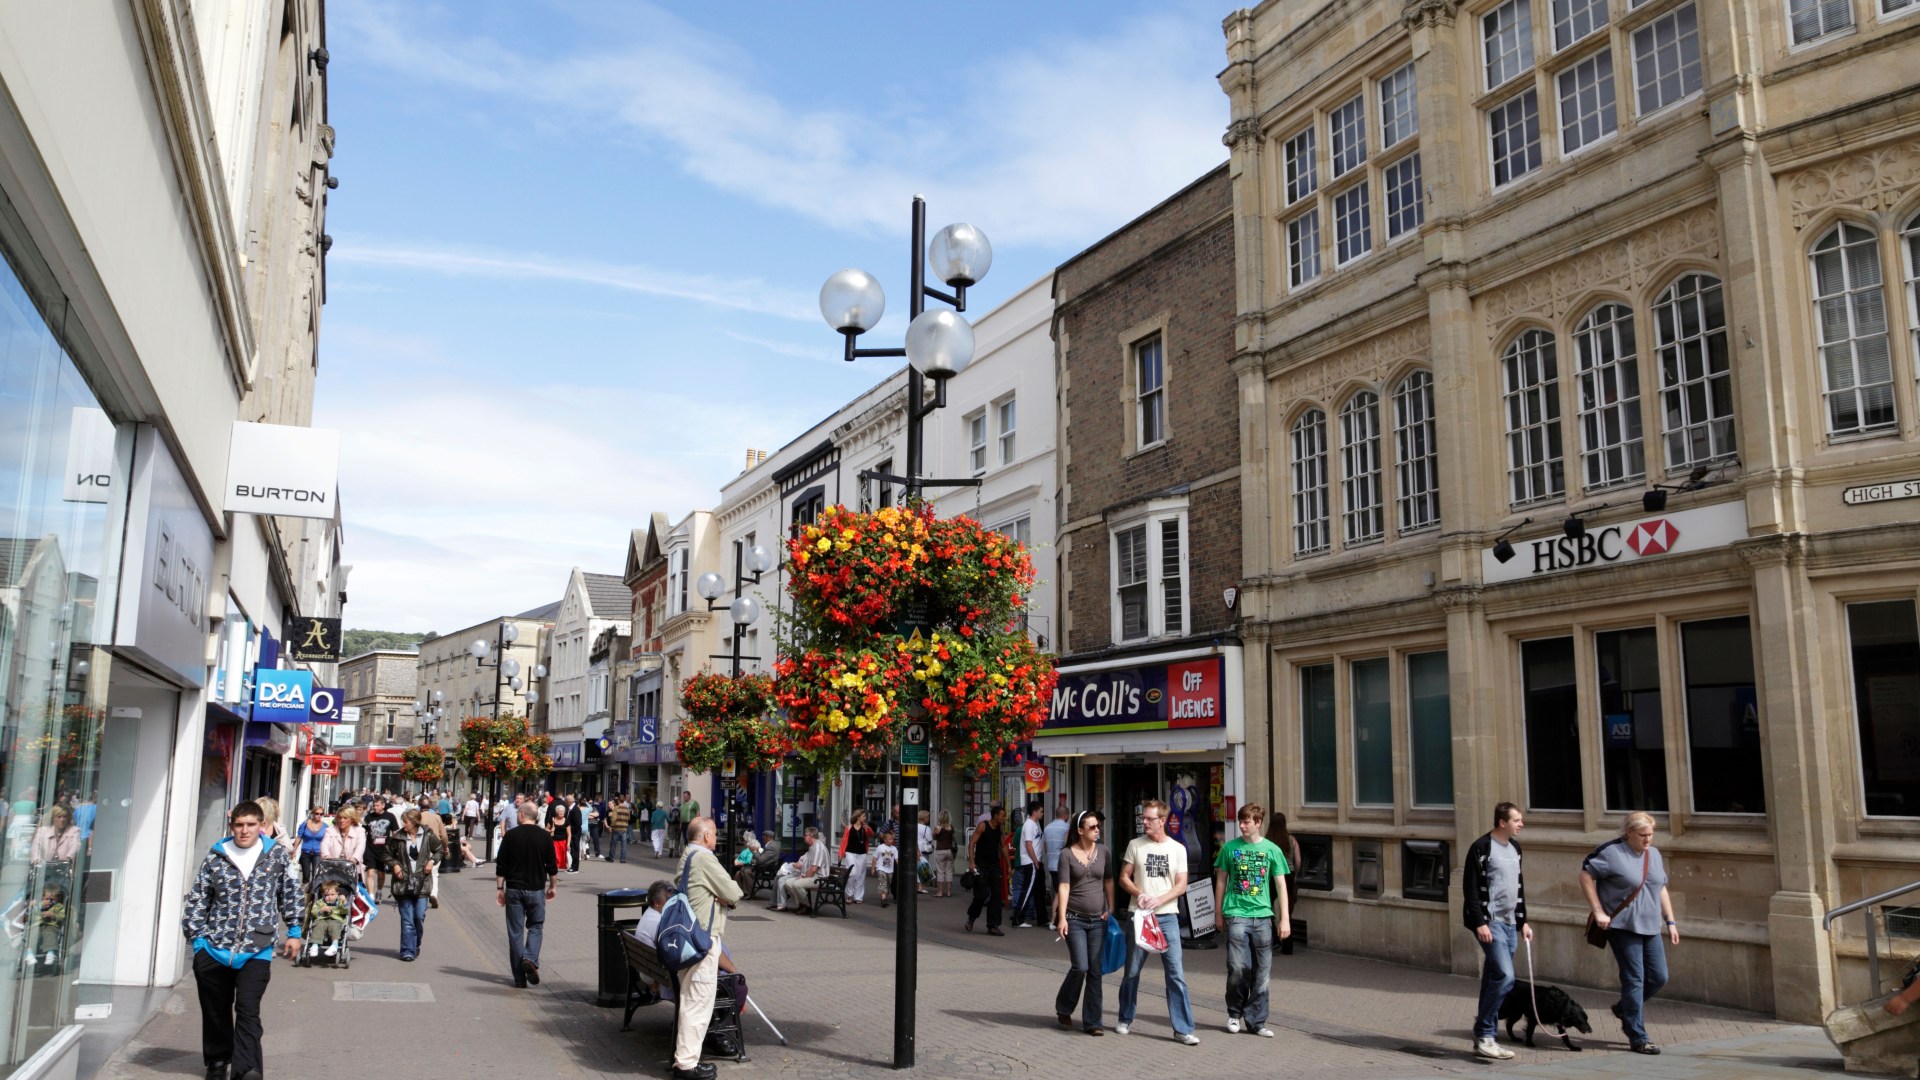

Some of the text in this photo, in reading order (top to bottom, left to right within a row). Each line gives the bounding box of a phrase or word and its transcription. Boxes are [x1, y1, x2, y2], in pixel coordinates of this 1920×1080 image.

[235, 484, 326, 503] BURTON
[1852, 485, 1893, 502] HIGH
[1532, 526, 1622, 573] HSBC
[301, 619, 331, 650] A
[295, 651, 335, 660] Accessorize
[259, 682, 305, 703] D&A
[272, 702, 305, 710] OPTICIANS
[310, 691, 339, 719] O2
[642, 724, 655, 743] S
[909, 791, 915, 800] 7
[1193, 924, 1216, 936] Mercur
